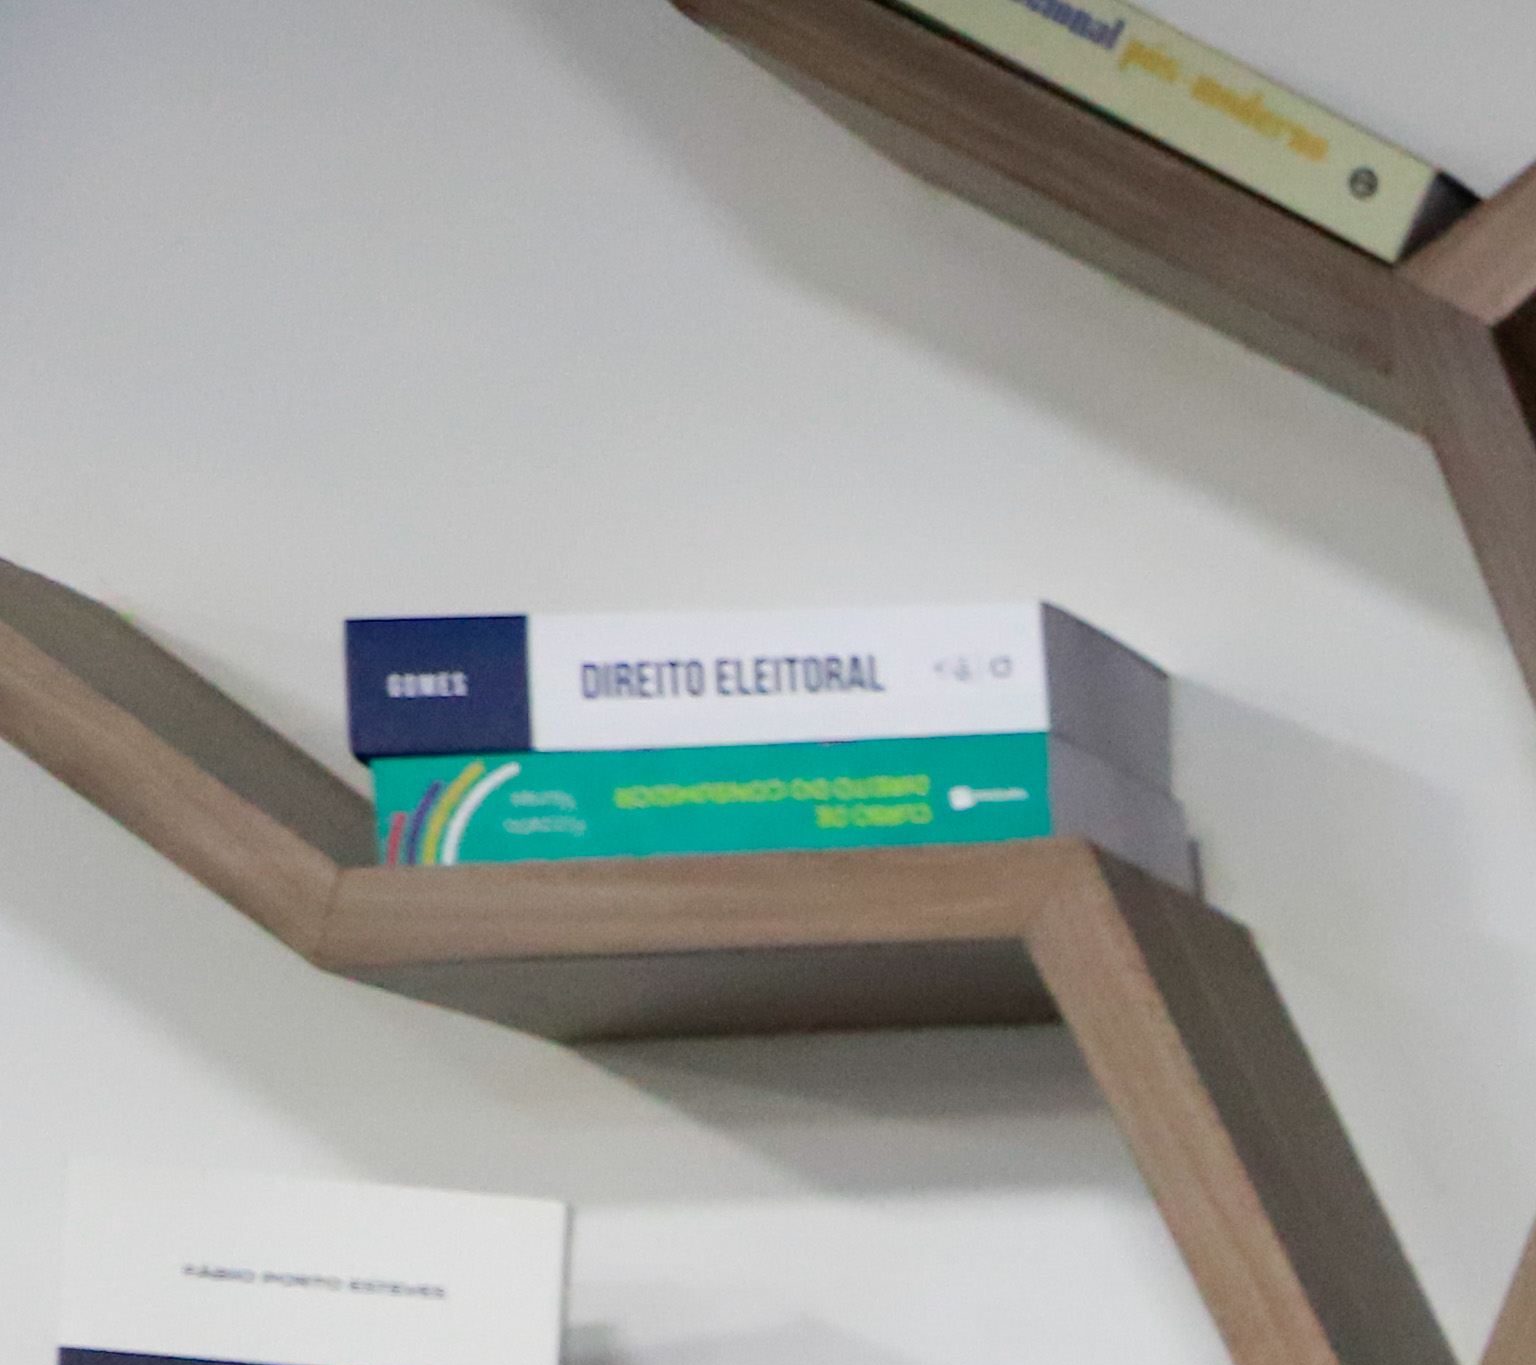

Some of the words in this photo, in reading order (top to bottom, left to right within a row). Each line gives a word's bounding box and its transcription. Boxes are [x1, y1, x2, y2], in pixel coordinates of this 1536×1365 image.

[386, 673, 469, 699] GOMES
[580, 660, 706, 699] DIREITO
[715, 654, 887, 694] ELEITORAL
